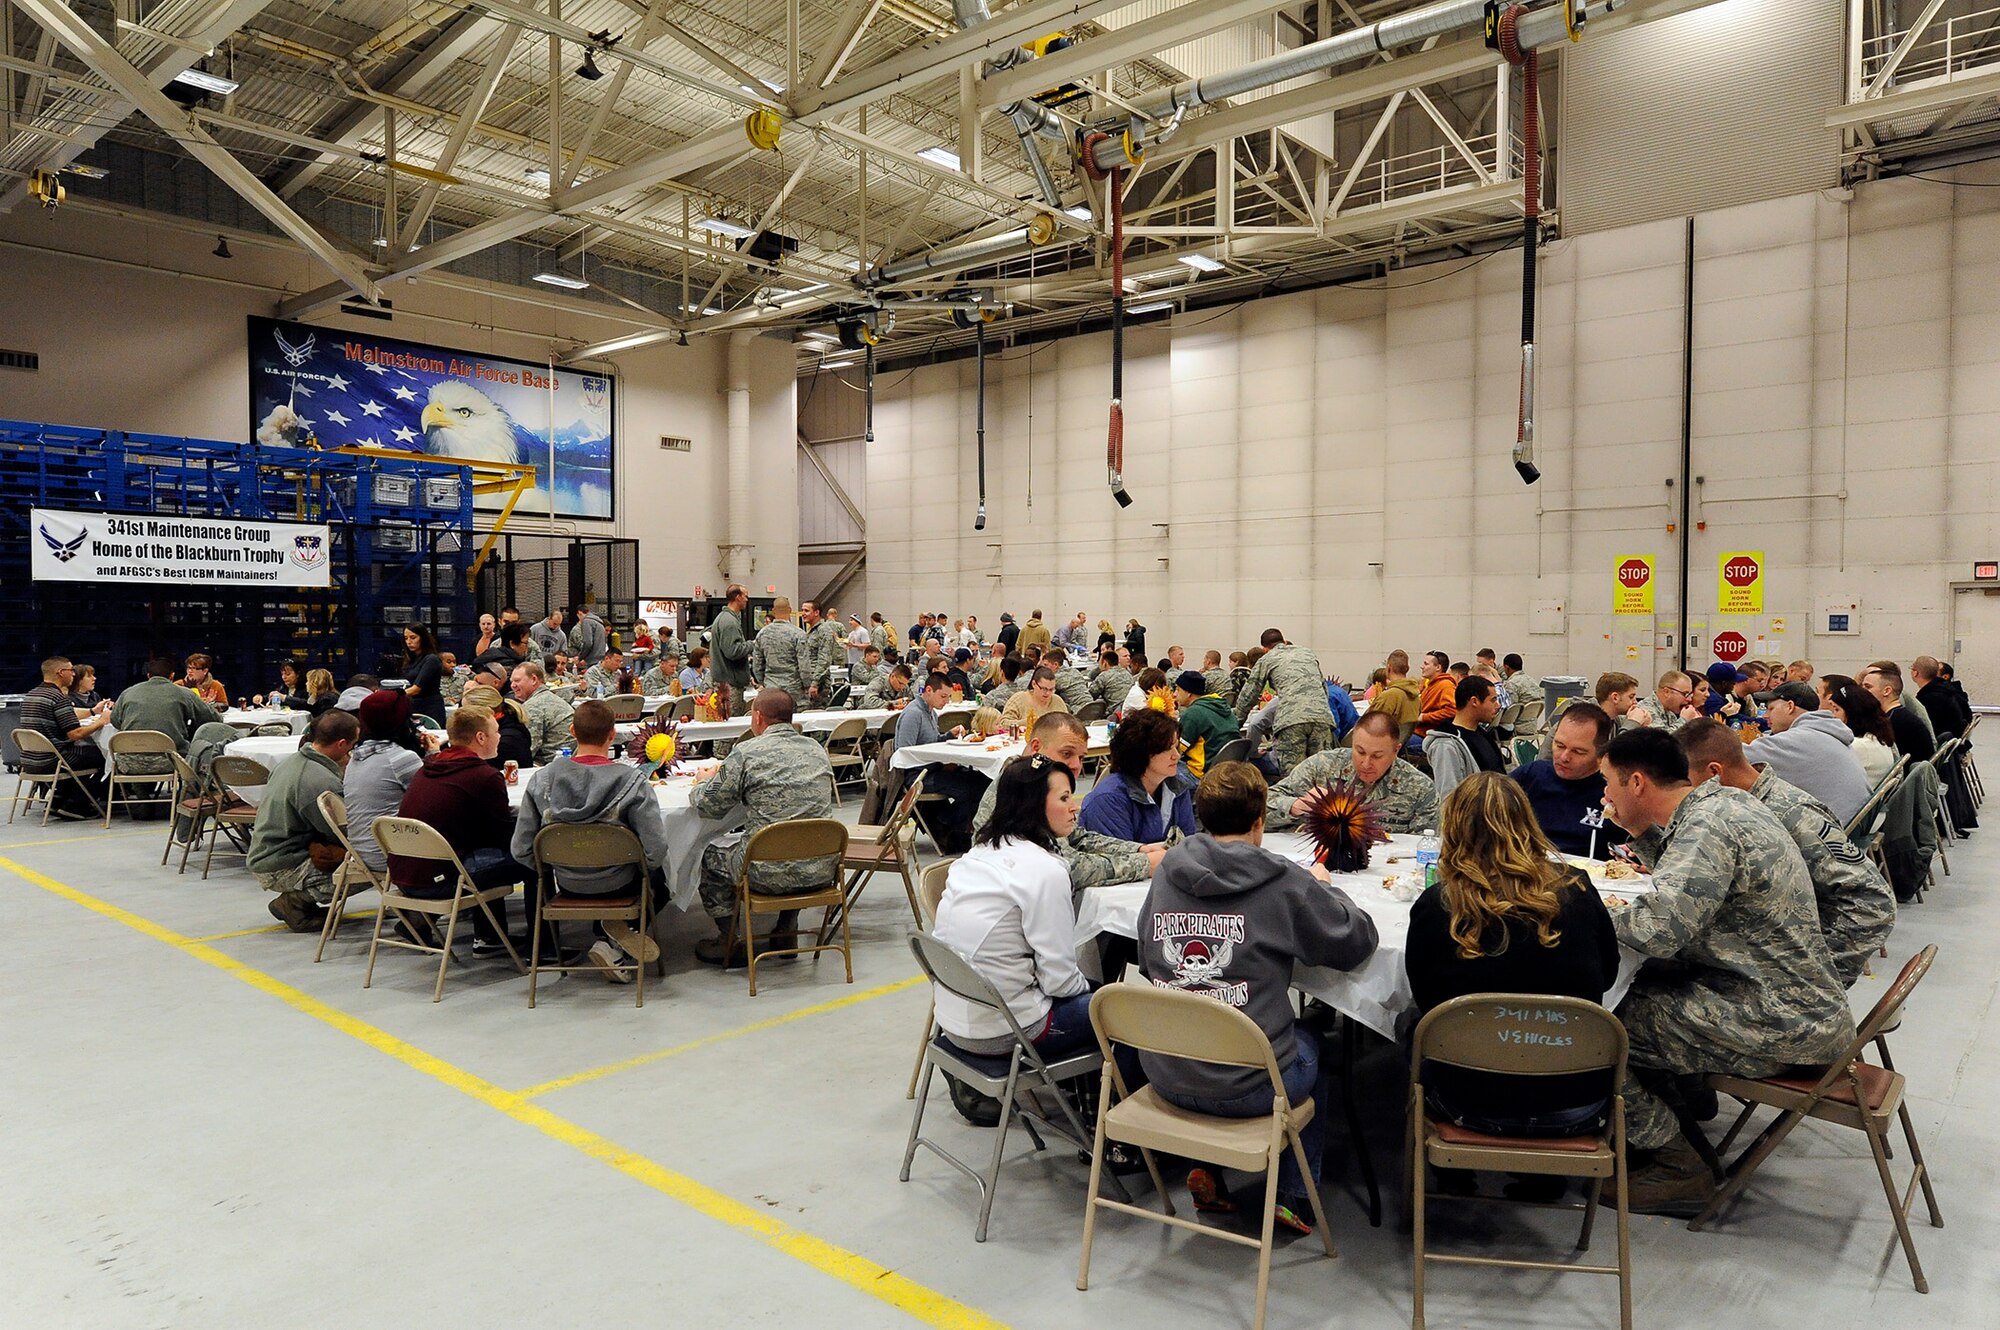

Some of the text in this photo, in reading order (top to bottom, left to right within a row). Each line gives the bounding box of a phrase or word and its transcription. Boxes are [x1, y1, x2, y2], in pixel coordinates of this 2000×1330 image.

[345, 341, 560, 391] Malmstrom Air Force Base
[264, 367, 280, 375] U.S.
[297, 371, 326, 381] FORCE
[108, 519, 271, 543] 341st Maintenance Group
[92, 541, 285, 565] Home of the Blackburn Trophy
[96, 566, 278, 580] and AFGSC's Best ICBM Maintainers!
[1620, 568, 1649, 580] STOP
[1725, 565, 1757, 578] STOP
[1979, 565, 1995, 576] EXIT
[1715, 640, 1746, 653] STOP
[1153, 913, 1245, 943] PARK PIRATES
[1497, 1029, 1574, 1046] VEHICLES
